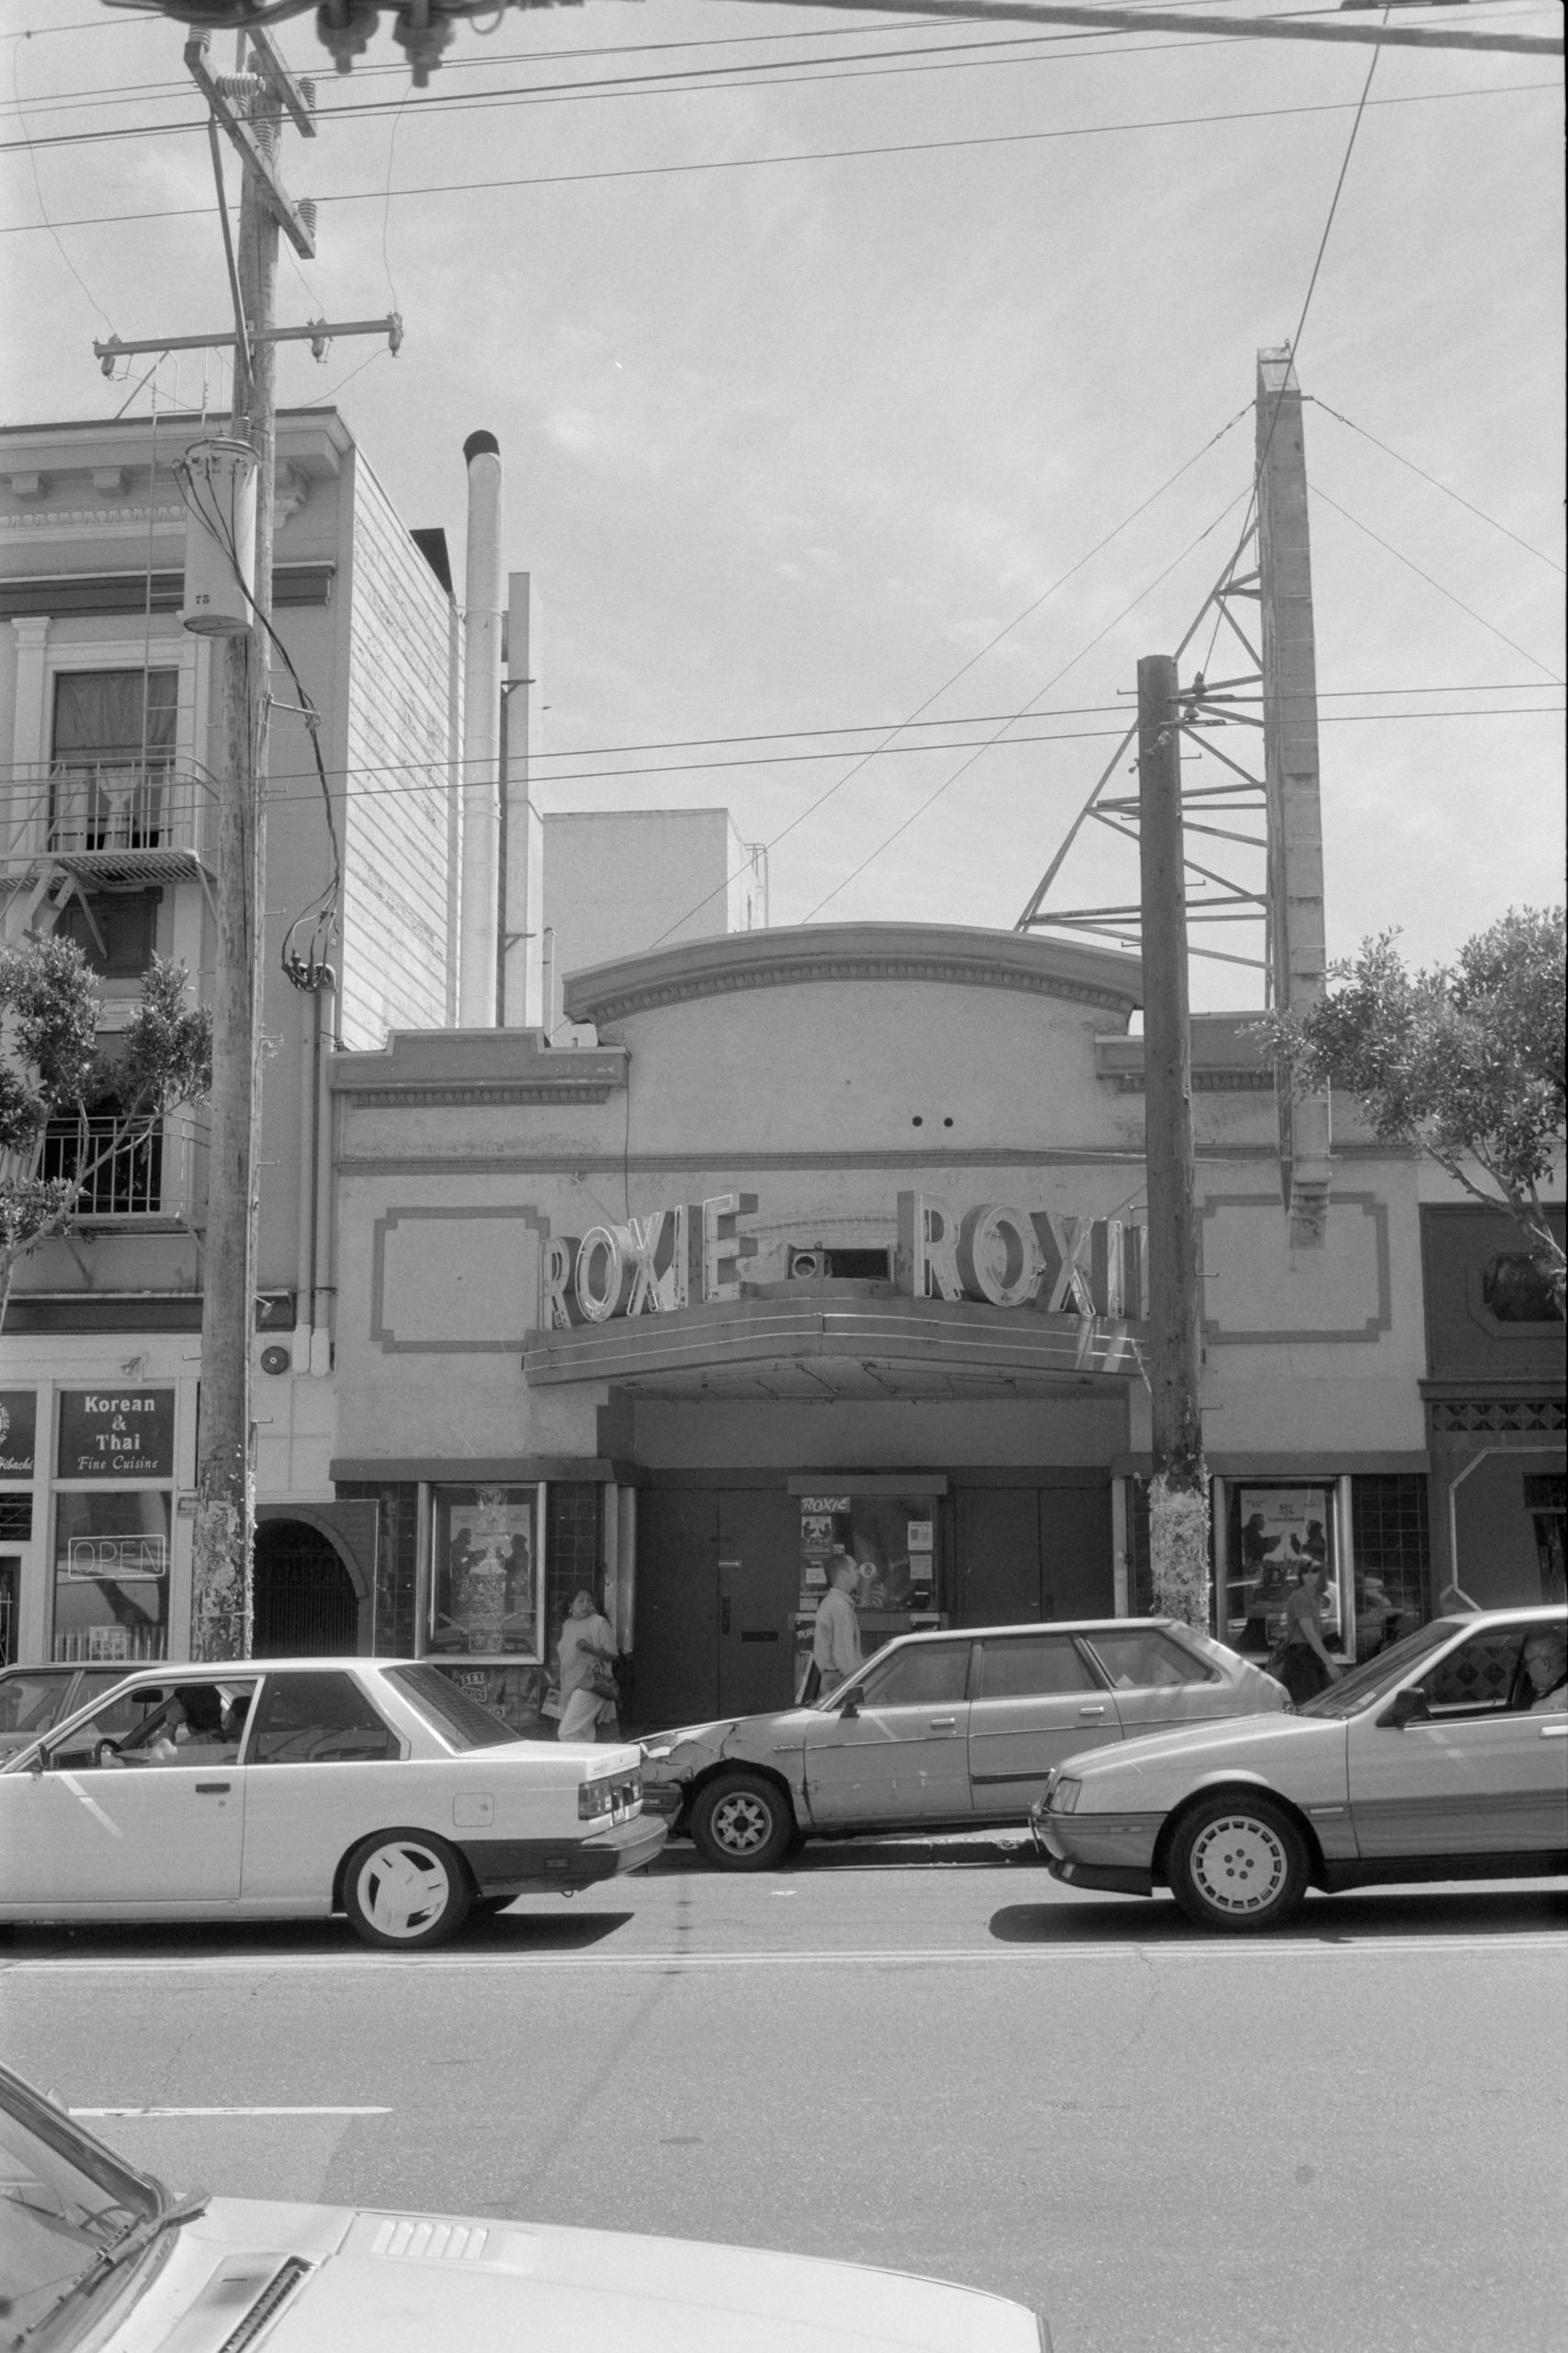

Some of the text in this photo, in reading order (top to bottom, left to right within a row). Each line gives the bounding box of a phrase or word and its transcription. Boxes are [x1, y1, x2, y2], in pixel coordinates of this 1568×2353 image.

[538, 1193, 758, 1332] ROXIE
[897, 1190, 1148, 1322] ROXI
[85, 1396, 155, 1413] Korean
[111, 1415, 127, 1431] &
[96, 1434, 141, 1450] Thai
[77, 1455, 159, 1471] Fine Cuisine
[801, 1496, 850, 1512] ROXIE
[74, 1540, 160, 1574] OPEN
[462, 1673, 483, 1684] SEX
